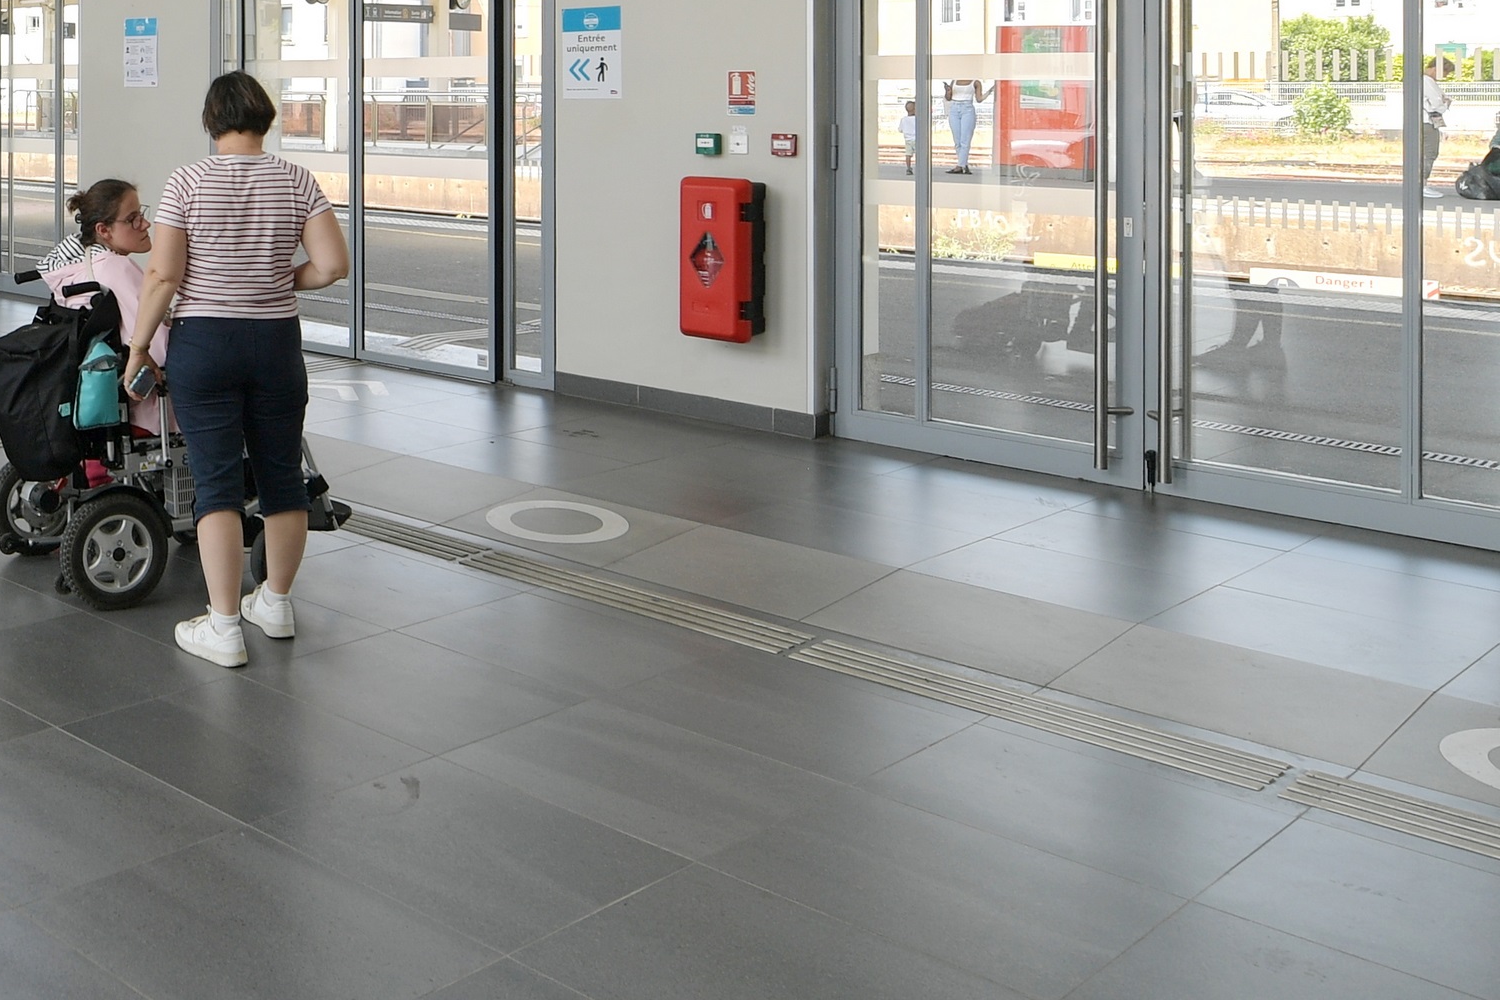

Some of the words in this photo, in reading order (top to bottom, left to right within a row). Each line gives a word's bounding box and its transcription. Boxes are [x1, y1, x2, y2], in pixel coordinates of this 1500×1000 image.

[577, 34, 606, 43] Entrée
[566, 43, 617, 54] uniquement
[1315, 275, 1364, 289] Danger
